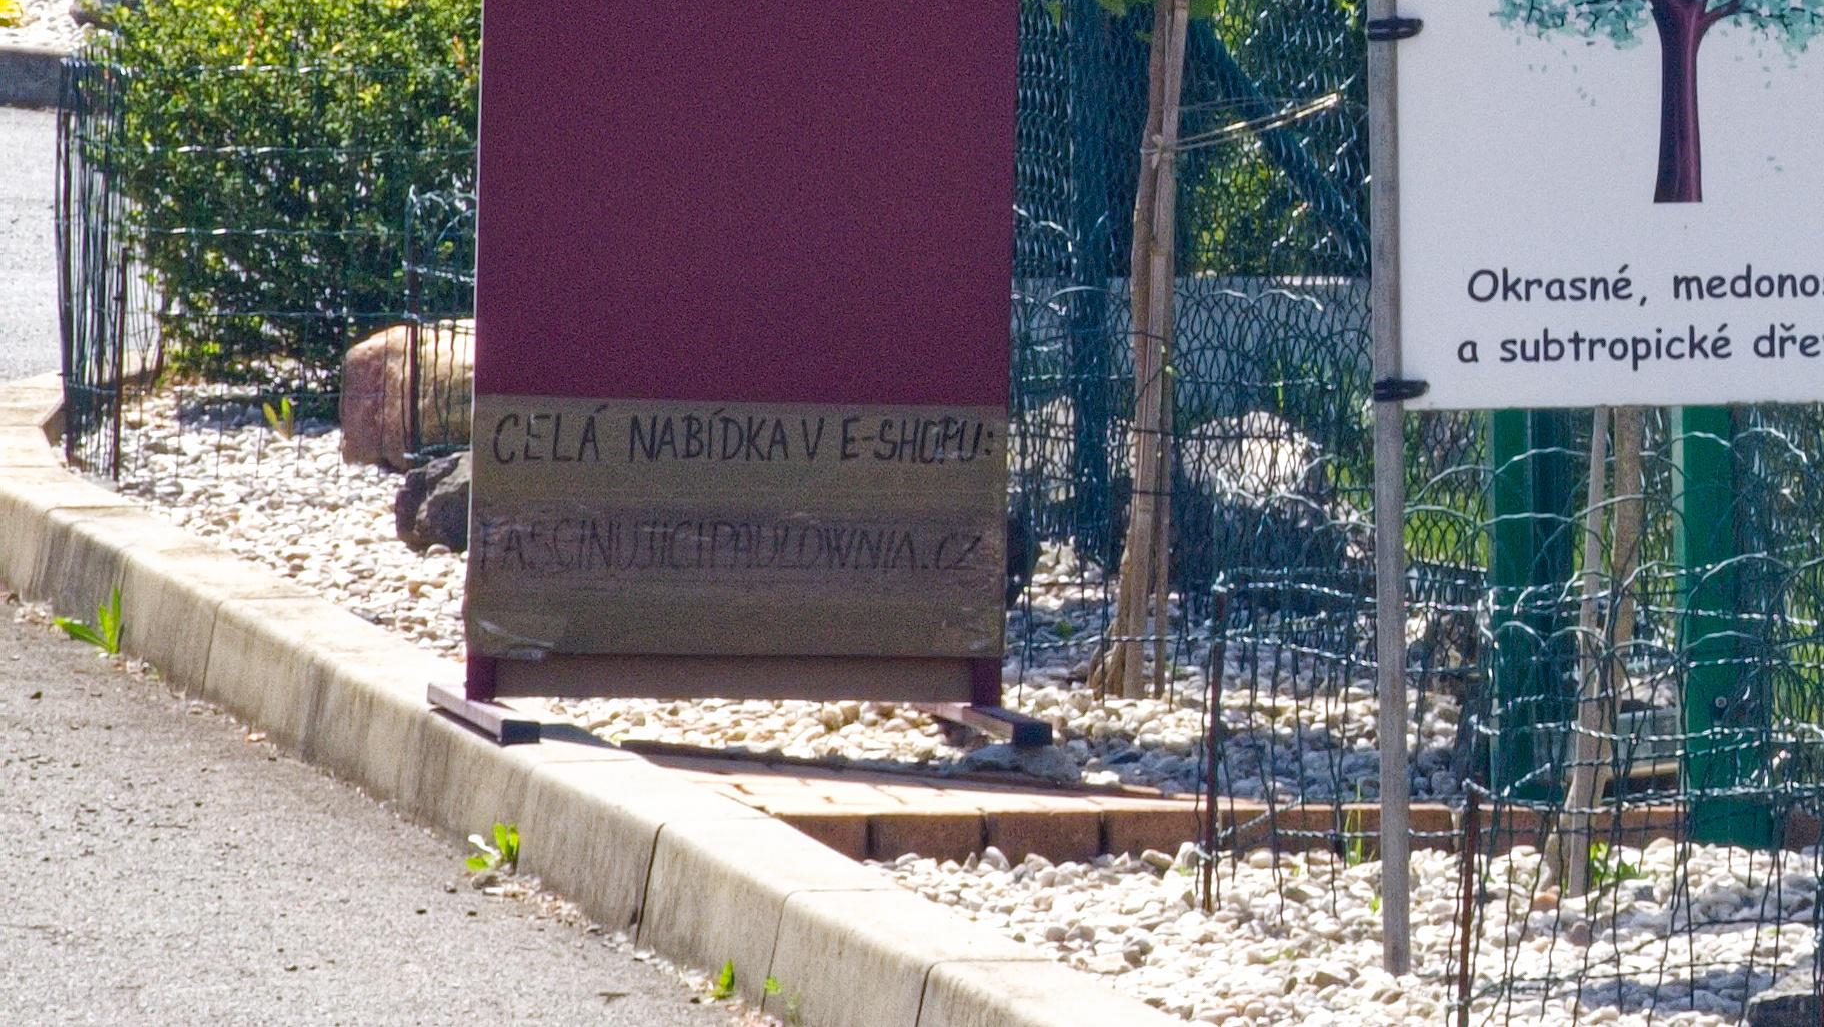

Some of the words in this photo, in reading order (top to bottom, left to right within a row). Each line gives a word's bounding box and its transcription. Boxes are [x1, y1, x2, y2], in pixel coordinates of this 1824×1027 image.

[1466, 263, 1649, 307] Okrasné,
[1456, 337, 1479, 364] a
[1499, 323, 1733, 372] subtropické
[492, 403, 609, 465] CELÁ
[628, 407, 789, 462] NABÍDKA
[801, 417, 825, 459] V
